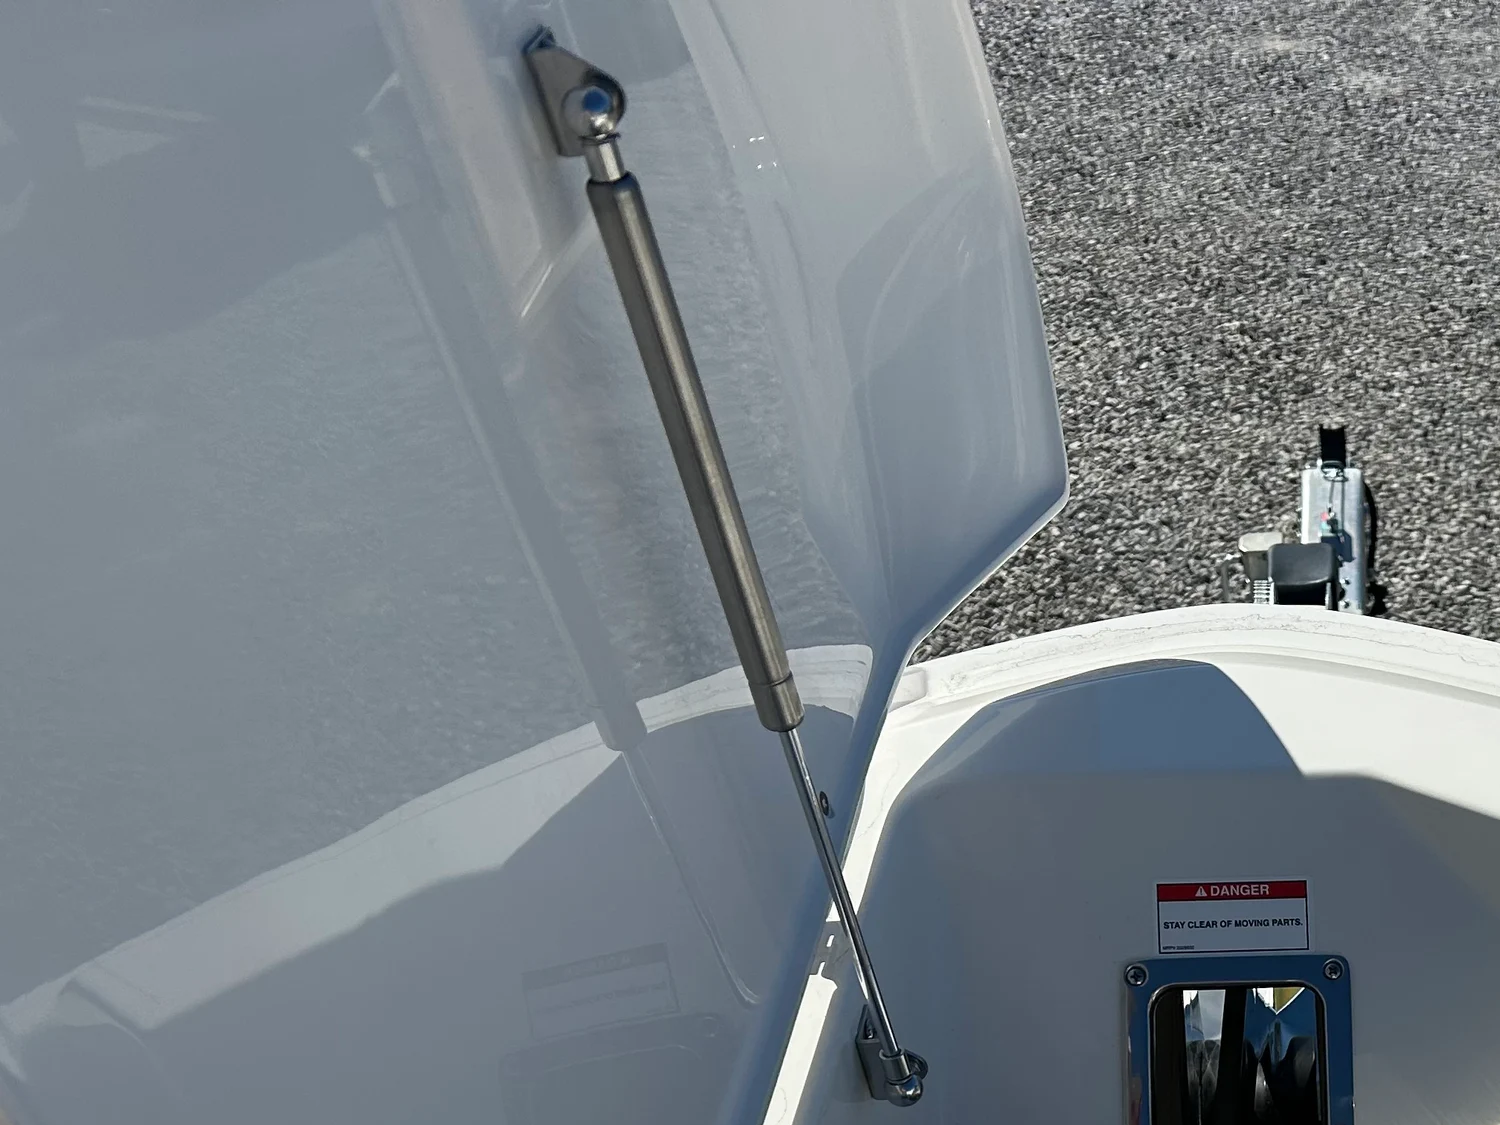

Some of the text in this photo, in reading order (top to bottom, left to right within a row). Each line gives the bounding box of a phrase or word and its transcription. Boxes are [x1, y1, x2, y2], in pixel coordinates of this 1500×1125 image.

[1210, 884, 1270, 897] DANGER
[1163, 918, 1304, 930] STAY CLEAR OF MOVING PARTS.
